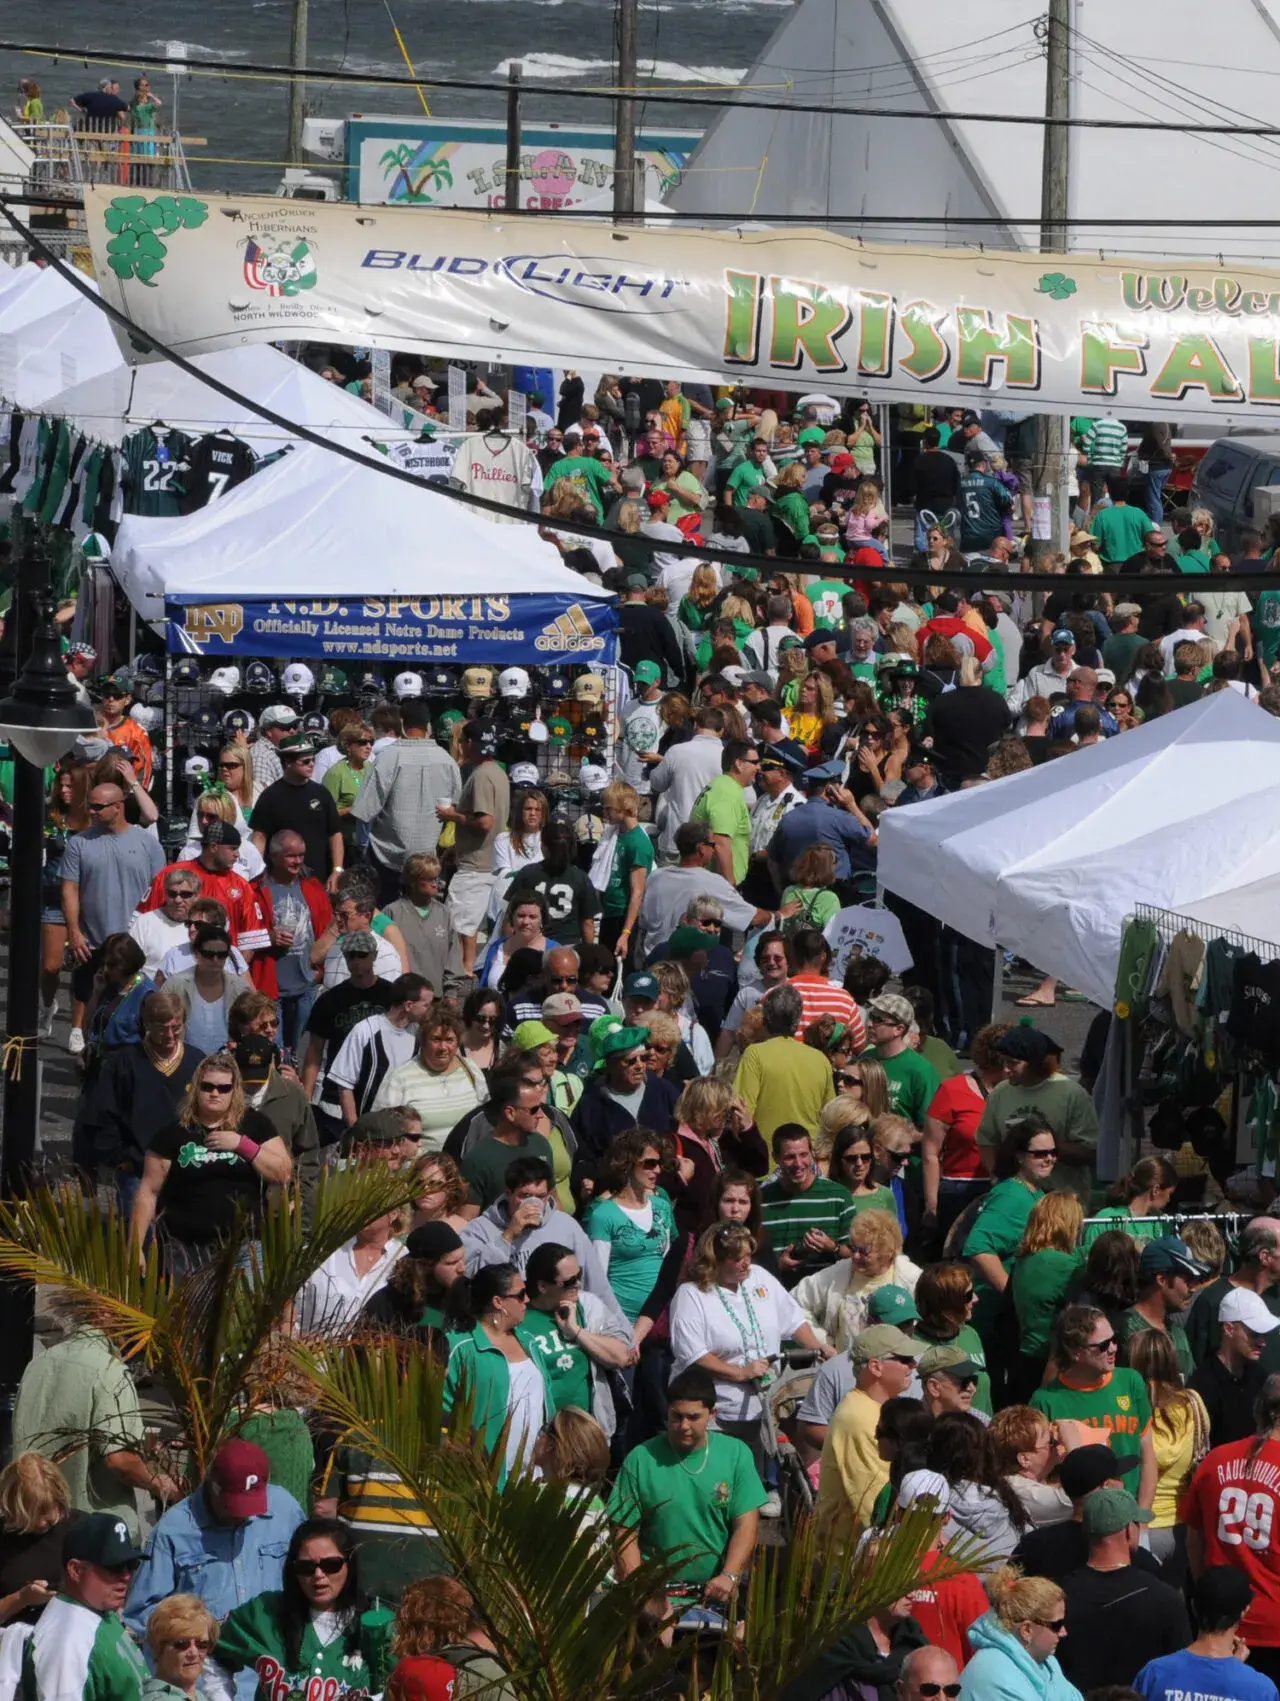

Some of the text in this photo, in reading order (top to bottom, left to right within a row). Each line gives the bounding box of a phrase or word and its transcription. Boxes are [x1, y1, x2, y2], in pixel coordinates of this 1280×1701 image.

[466, 154, 616, 196] ISLAN
[249, 221, 318, 233] HIBERNIANS
[360, 249, 691, 299] BUD LIGHT
[233, 310, 266, 321] NORTH
[722, 267, 1043, 391] IRISH
[211, 450, 234, 465] VICK
[143, 460, 177, 492] 22
[471, 462, 518, 483] Phillies
[207, 471, 230, 505] 7
[965, 491, 980, 519] 5
[362, 595, 511, 622] SPORTS
[253, 618, 525, 642] Officially Licensed Notre Dame Products
[322, 639, 459, 658] www.ndsports.net
[534, 635, 606, 652] adidas
[244, 1473, 259, 1491] P
[1217, 1486, 1275, 1550] 29
[114, 1521, 127, 1543] P
